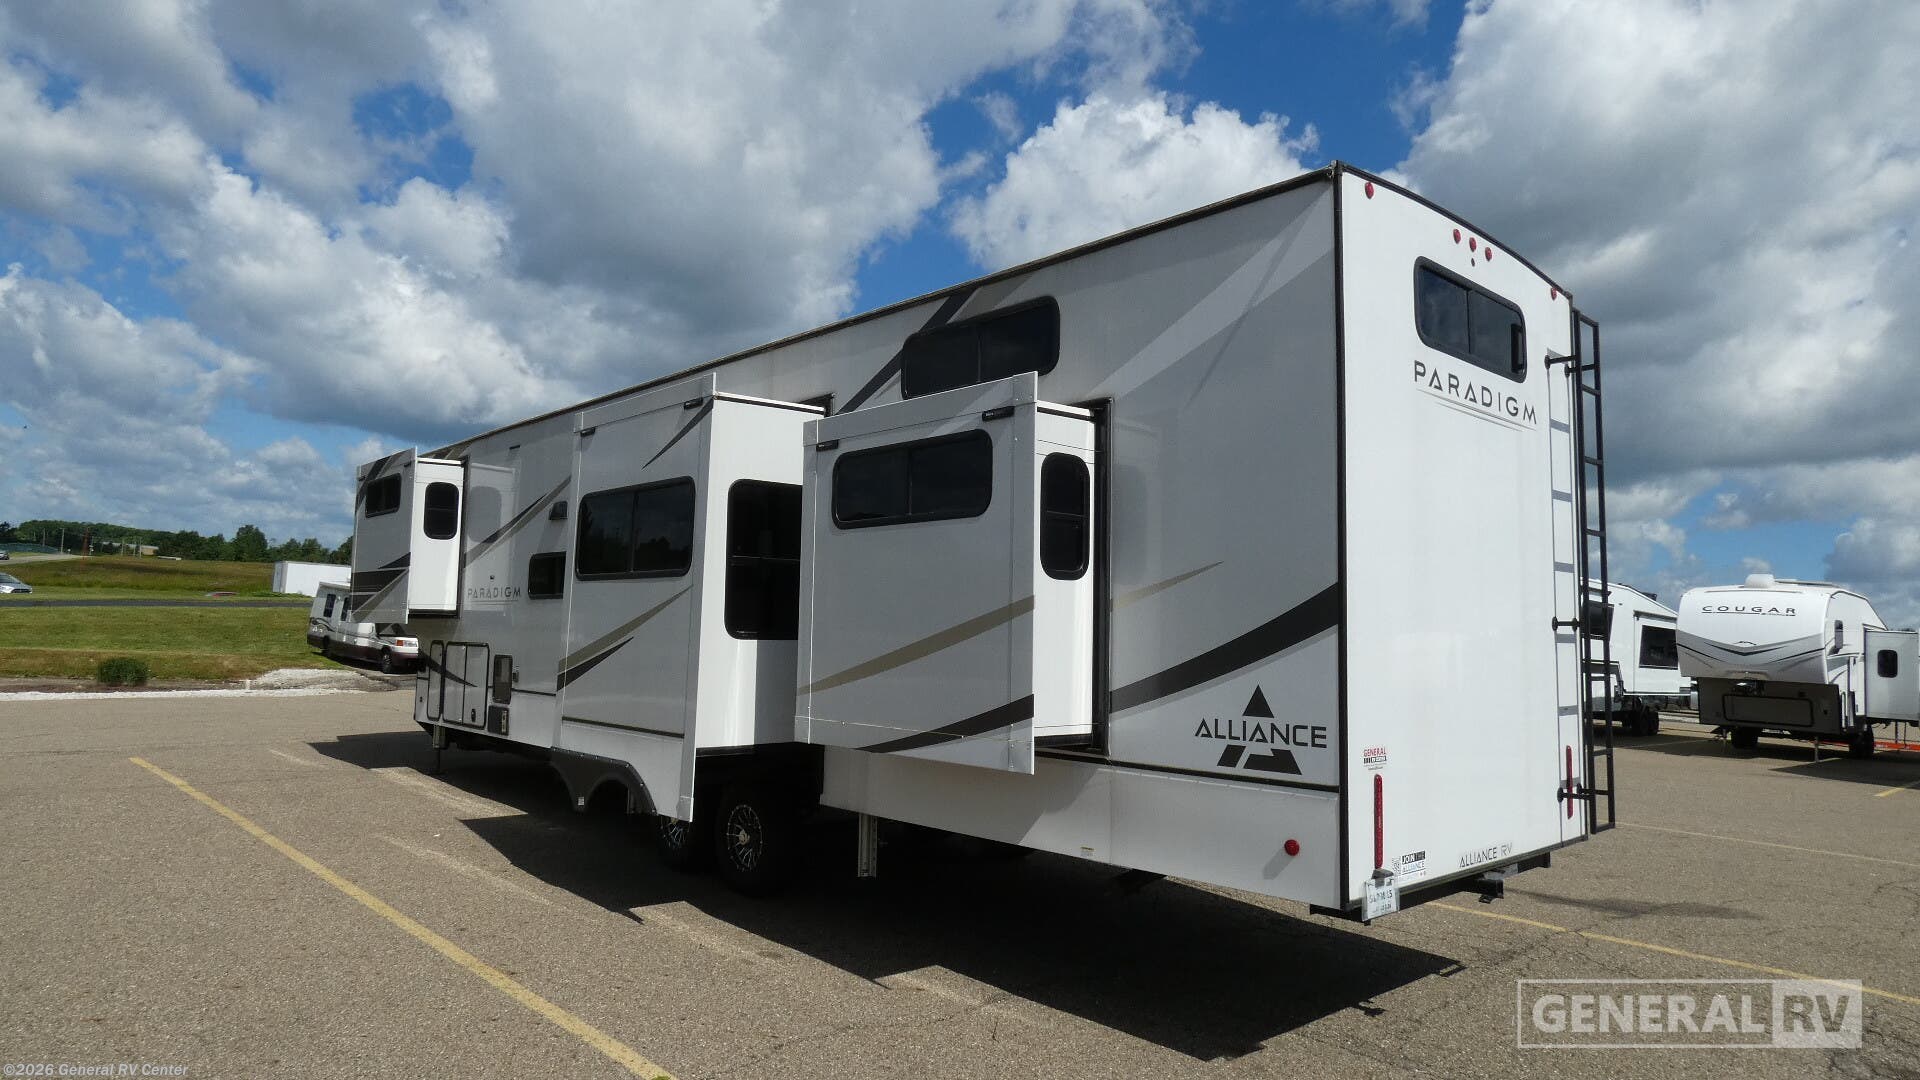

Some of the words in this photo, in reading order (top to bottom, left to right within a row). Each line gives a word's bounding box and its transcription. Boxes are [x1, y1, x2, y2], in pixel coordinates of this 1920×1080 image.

[1414, 360, 1537, 425] PARADIGM
[467, 586, 521, 599] PARADIGM
[1702, 605, 1796, 615] COUGAR
[1194, 717, 1327, 749] ALLIANCE
[1363, 747, 1387, 757] GENERAL
[1459, 846, 1497, 868] ALLIANCE
[1500, 842, 1513, 857] RV
